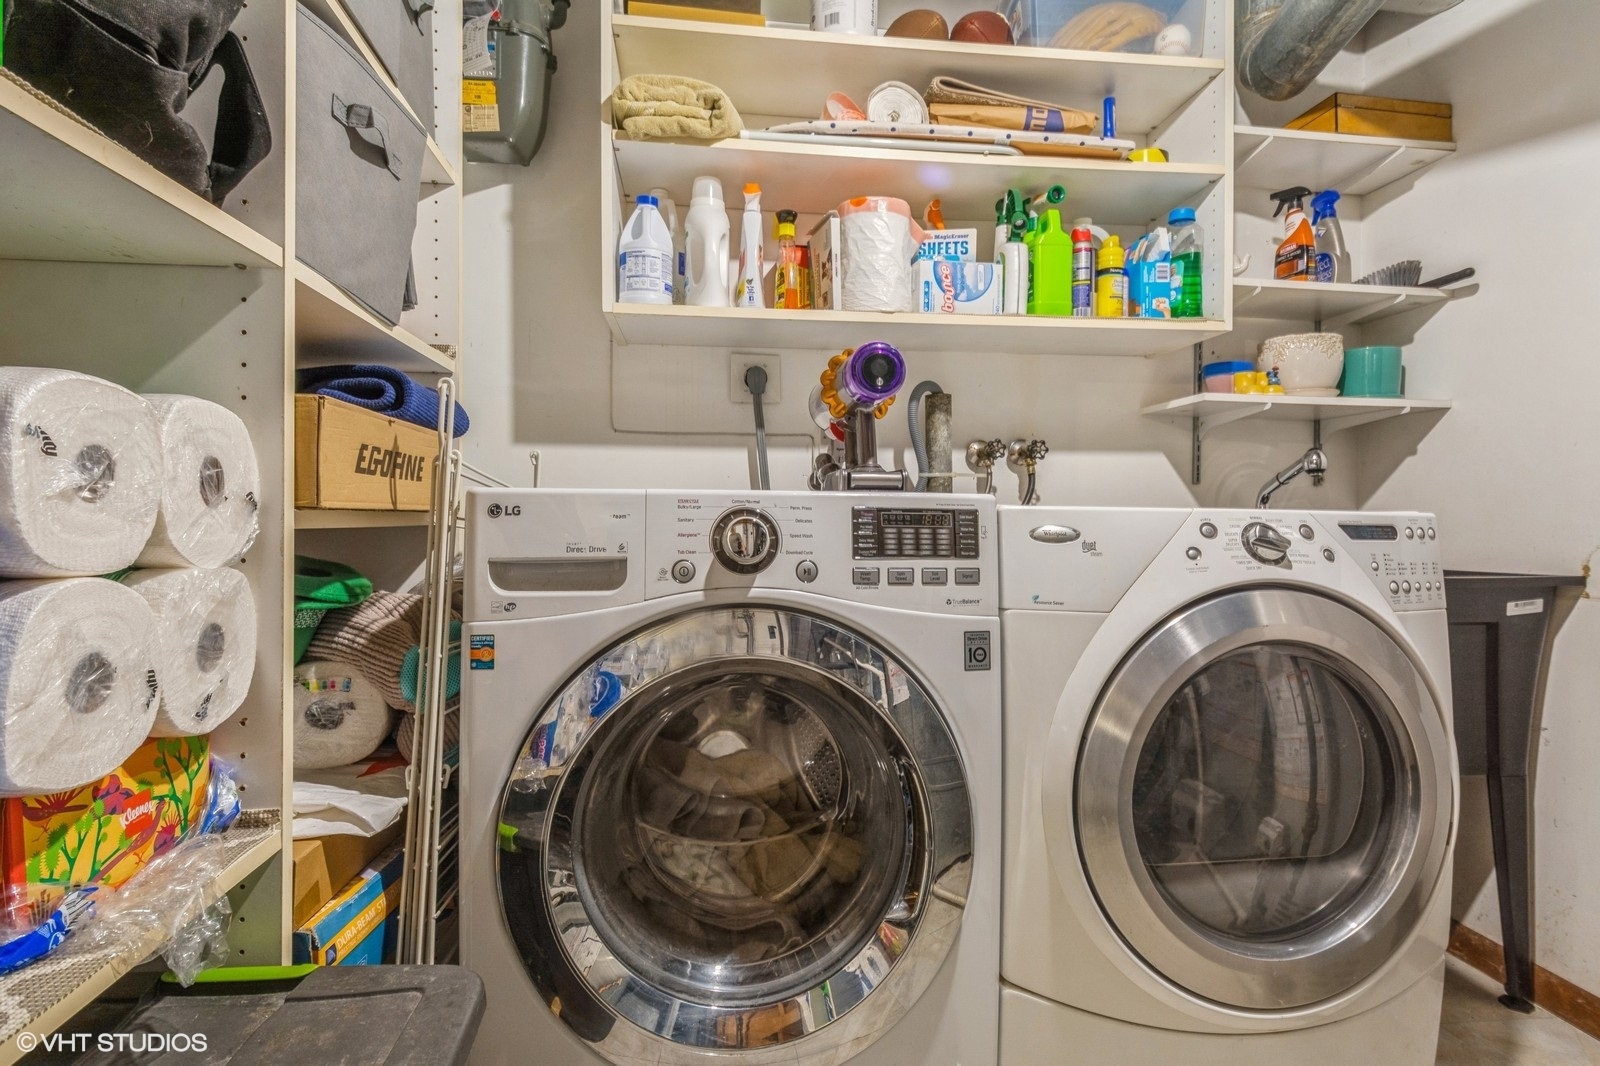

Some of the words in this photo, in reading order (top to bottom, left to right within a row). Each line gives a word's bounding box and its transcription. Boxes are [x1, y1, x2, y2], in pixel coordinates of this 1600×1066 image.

[919, 240, 969, 255] SHEETS
[941, 264, 955, 313] bounce
[354, 443, 426, 482] EGOFINE
[504, 505, 521, 516] LG
[1081, 540, 1097, 551] duet
[120, 800, 160, 829] Kleenex
[337, 909, 377, 950] DURA-BEAM
